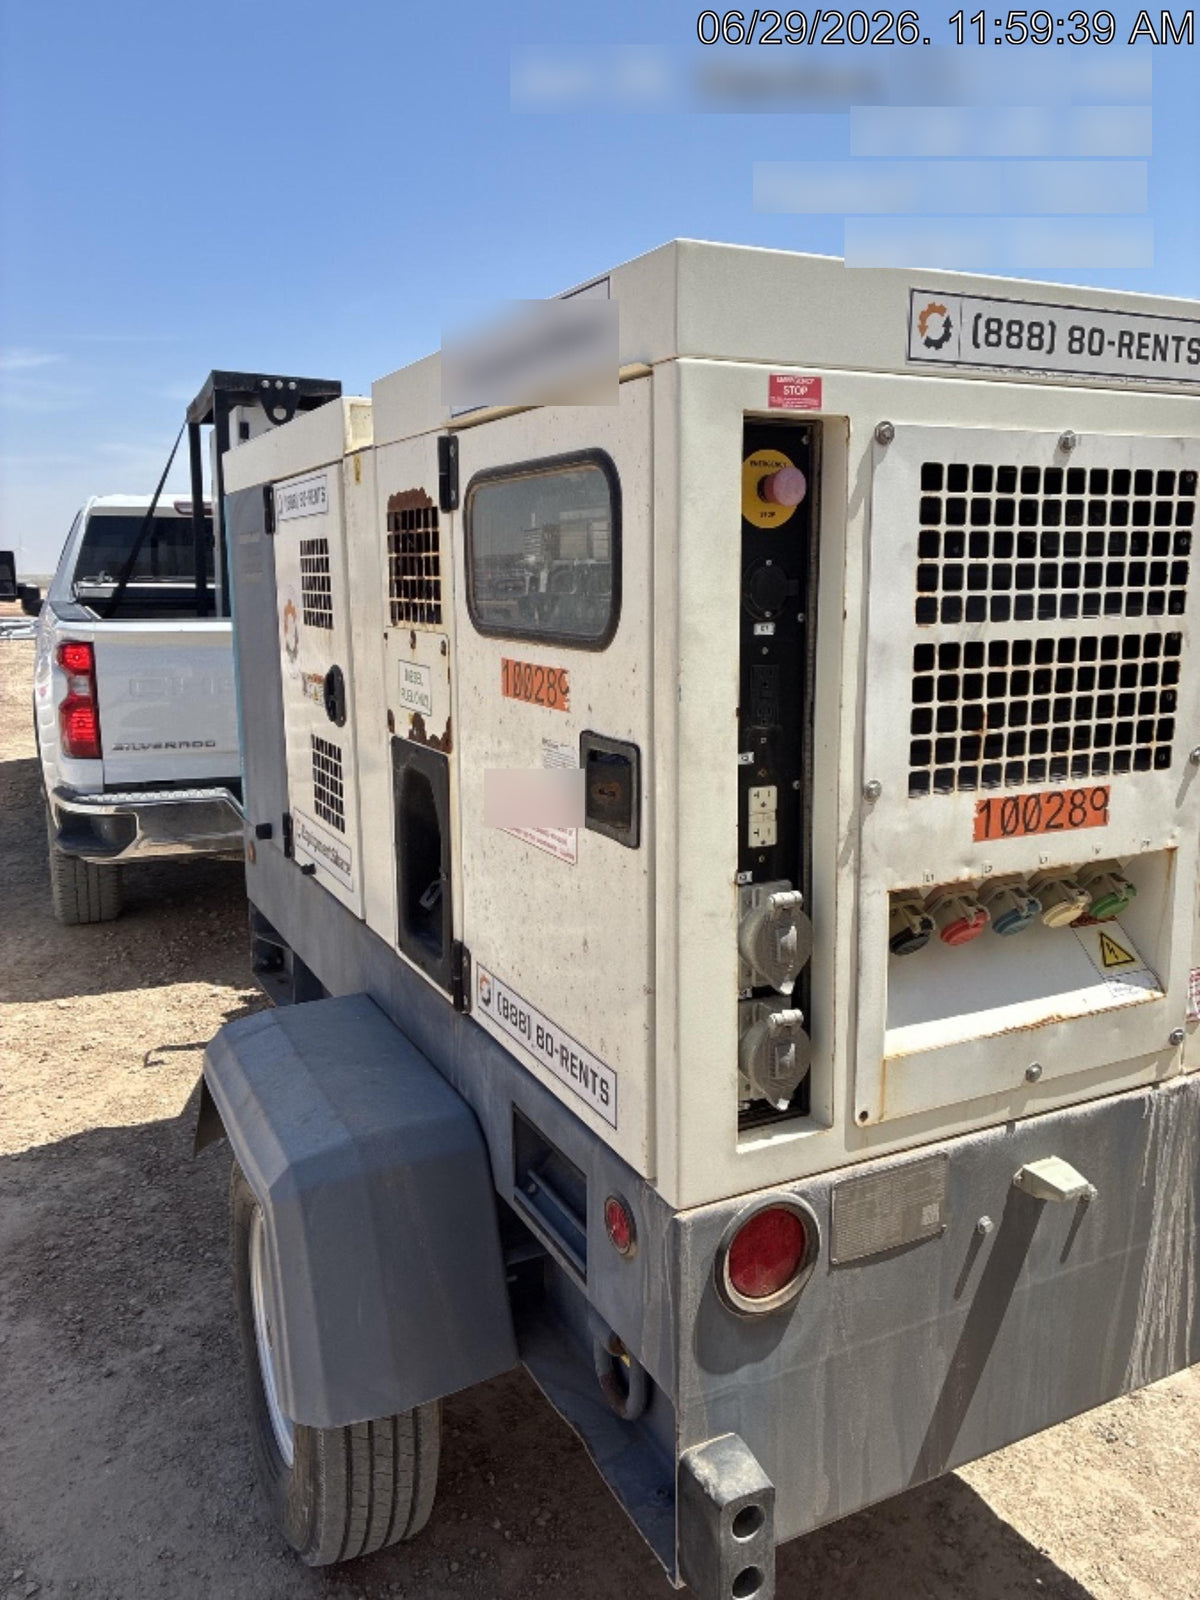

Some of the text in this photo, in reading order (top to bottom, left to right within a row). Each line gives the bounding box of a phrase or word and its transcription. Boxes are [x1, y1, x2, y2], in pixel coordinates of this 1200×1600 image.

[972, 313, 1200, 365] (888) 80-RENTS
[783, 385, 808, 396] STOP
[112, 740, 216, 751] SILVERADO
[978, 785, 1110, 838] 100289
[497, 991, 609, 1107] (888) 80-RENTS
